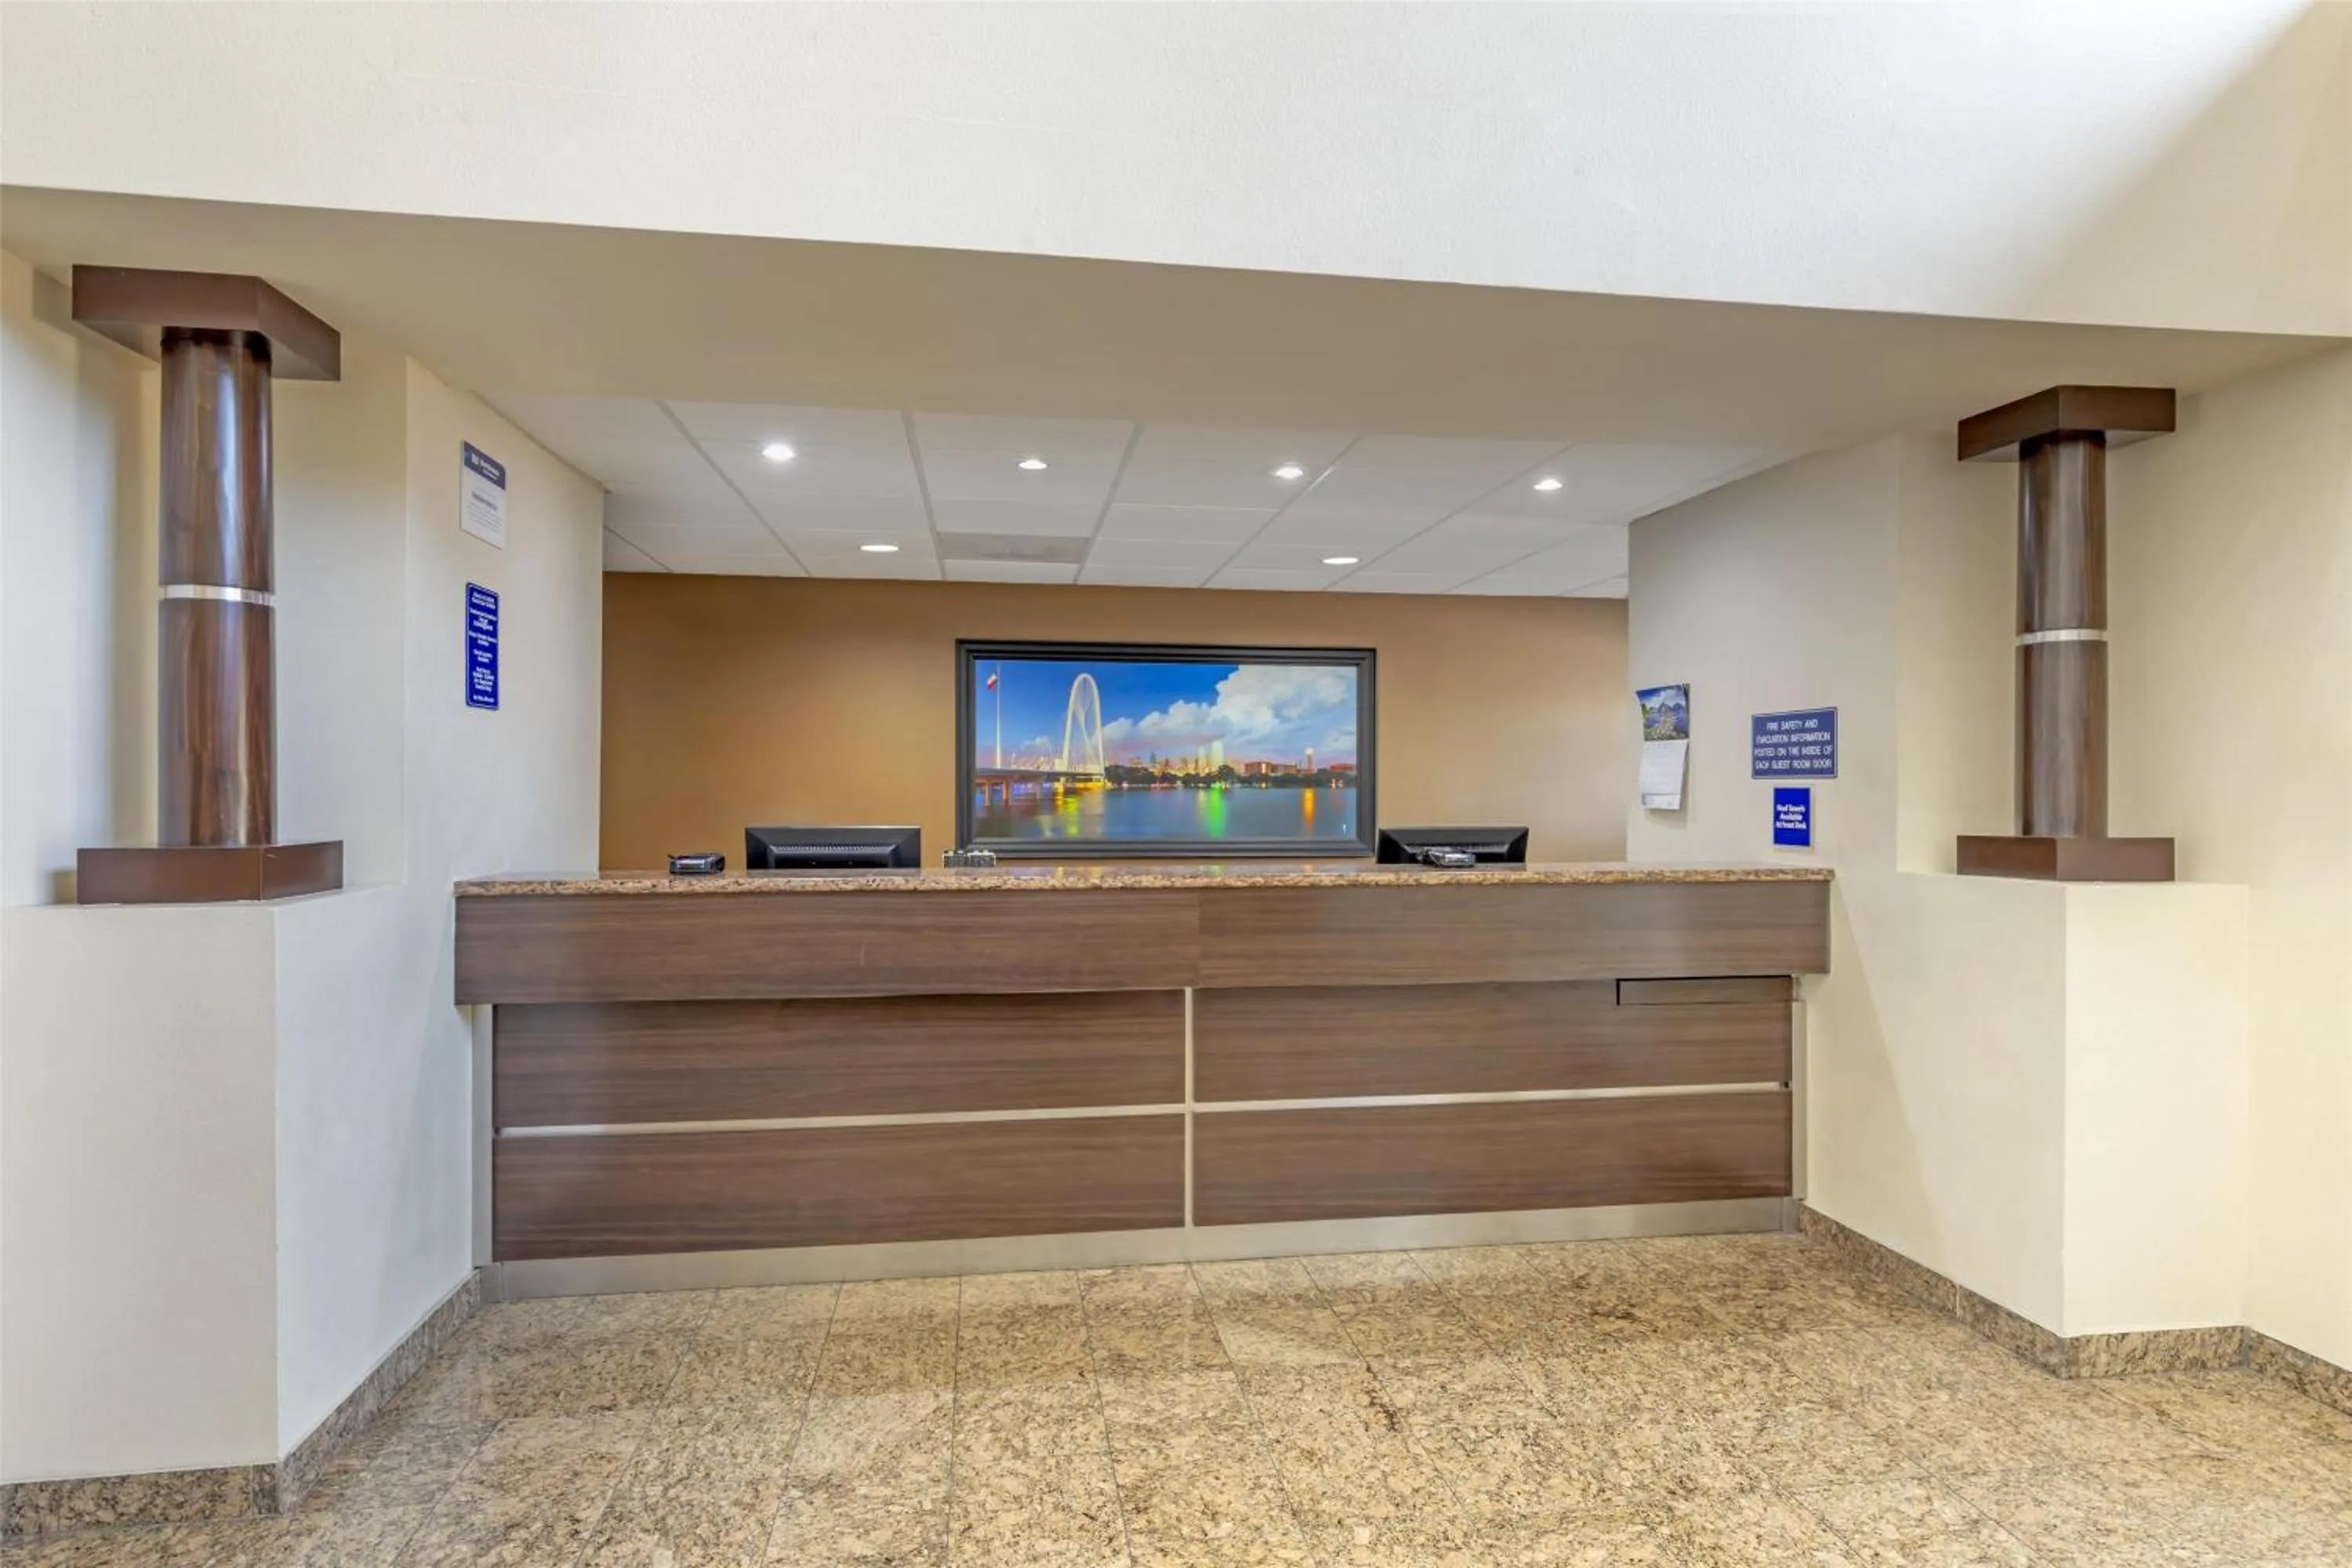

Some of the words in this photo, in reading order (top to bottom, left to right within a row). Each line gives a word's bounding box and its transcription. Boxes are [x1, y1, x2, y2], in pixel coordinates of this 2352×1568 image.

[1780, 720, 1802, 730] SAFETY
[1805, 719, 1818, 728] AND
[1790, 731, 1831, 742] INFORMATION
[1755, 747, 1775, 757] POSTED
[1777, 747, 1787, 756] ON
[1788, 746, 1800, 755] THE
[1801, 746, 1821, 755] INSIDE
[1823, 745, 1832, 754] OF
[1755, 760, 1769, 769] EACH
[1771, 760, 1791, 769] GUEST
[1792, 760, 1810, 768] ROOM
[1812, 759, 1832, 768] DOOR
